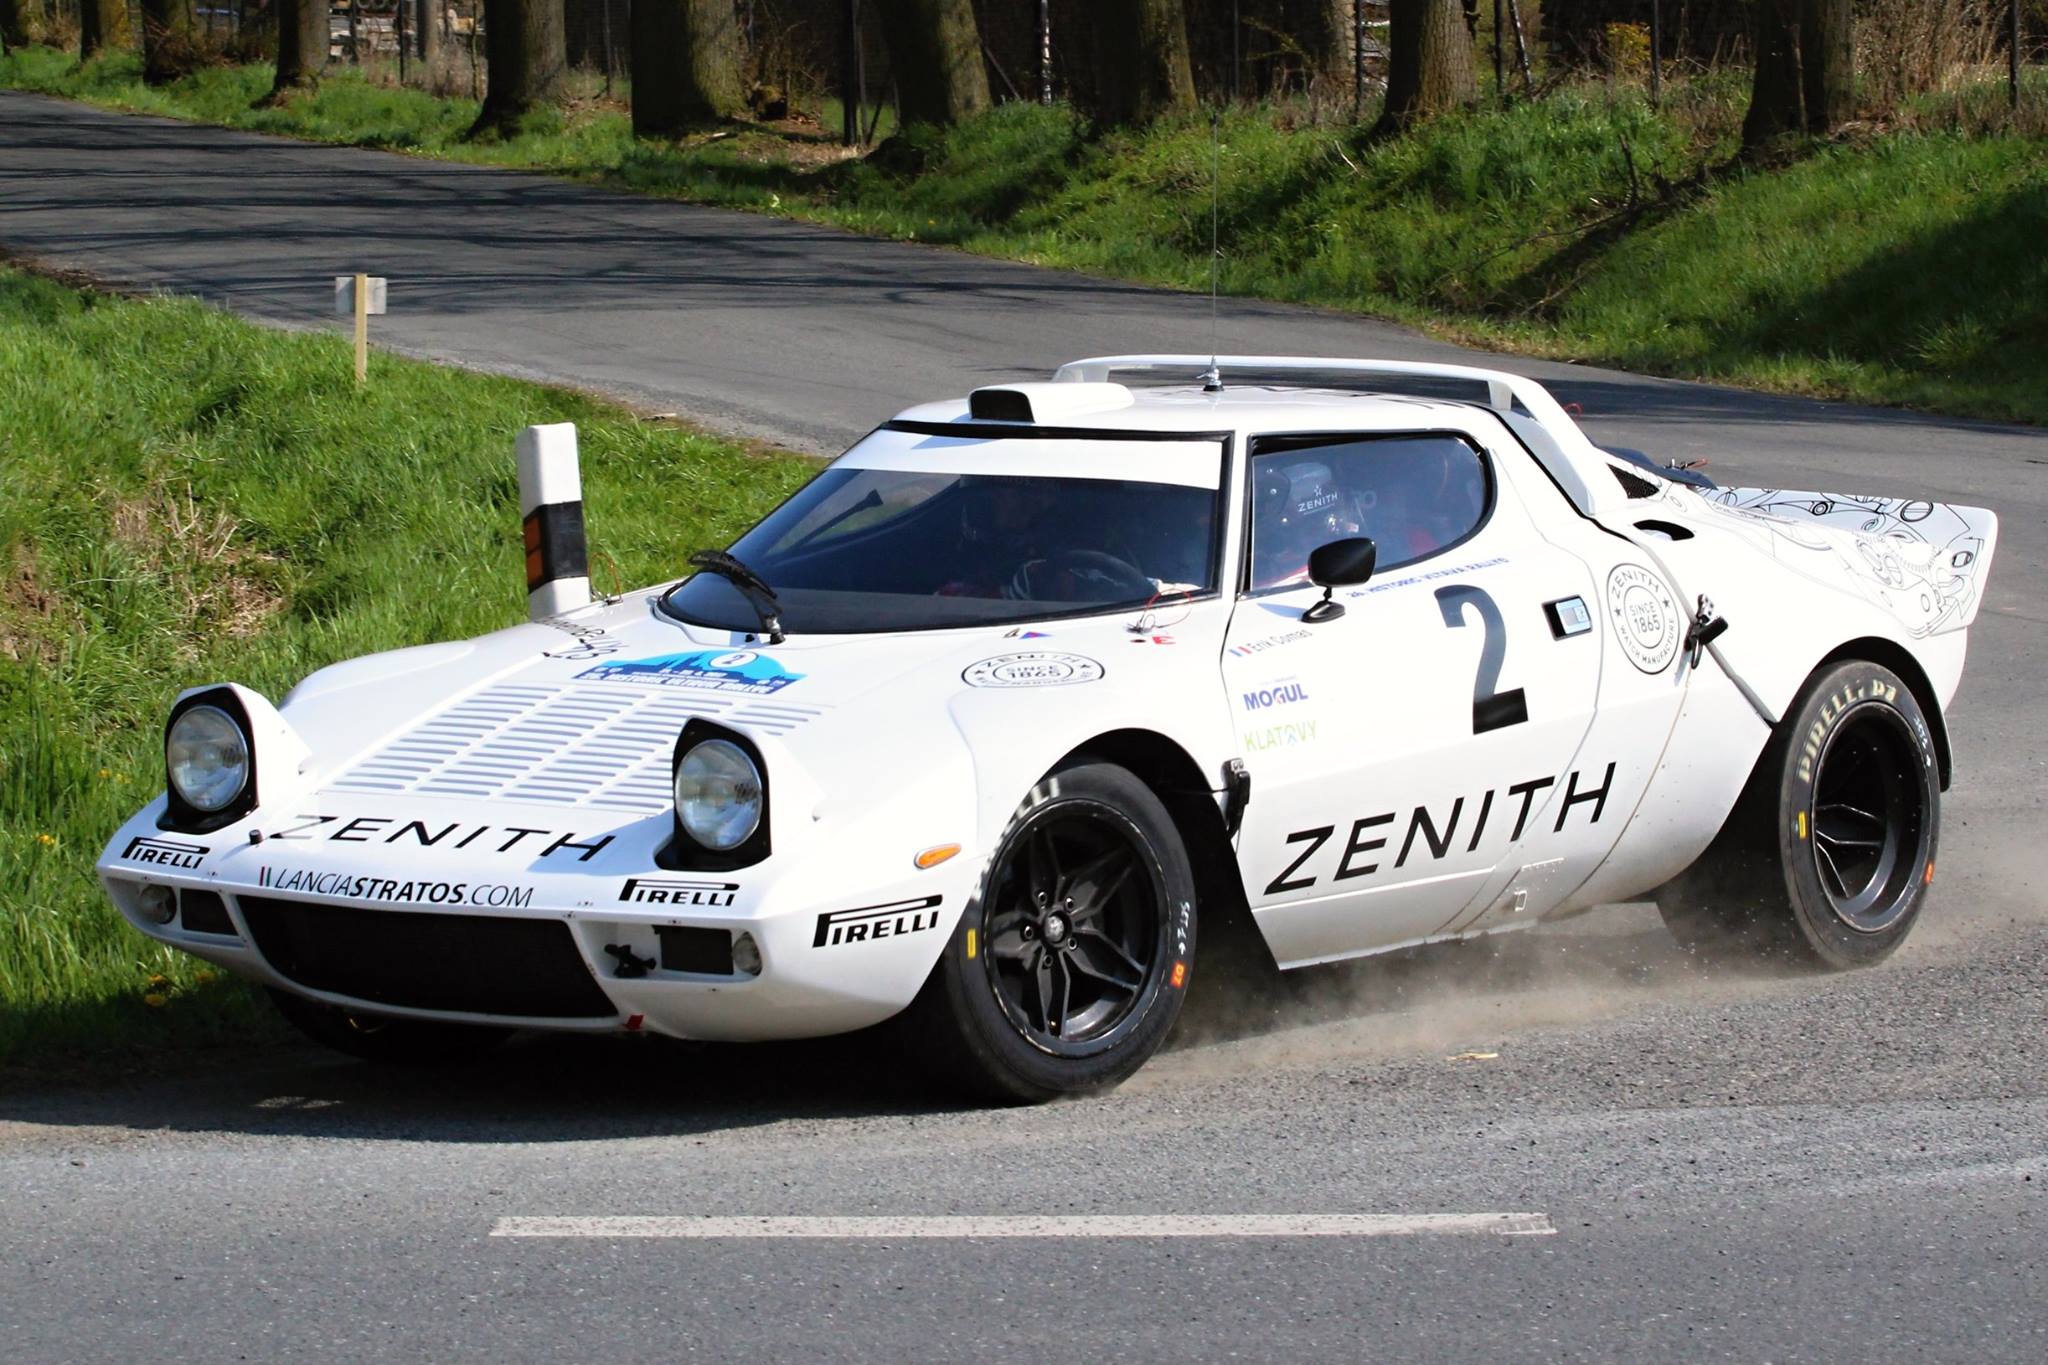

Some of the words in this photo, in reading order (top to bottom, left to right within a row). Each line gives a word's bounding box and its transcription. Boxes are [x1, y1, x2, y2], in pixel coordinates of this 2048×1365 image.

[1297, 492, 1338, 513] ZENITH
[1611, 570, 1660, 599] ZENITH
[1629, 601, 1656, 616] SINCE
[1633, 614, 1660, 634] 1865
[1642, 619, 1675, 665] MANUFACTURE
[1434, 584, 1528, 735] 2
[1243, 683, 1309, 711] MOGUL
[1244, 720, 1318, 752] KLATOVY
[1798, 679, 1865, 784] PIRELLI
[270, 815, 616, 862] ZENITH
[1263, 762, 1617, 896] ZENITH
[121, 836, 210, 869] PIRELLI
[274, 868, 535, 908] LANCIASTRATOS.COM
[618, 878, 740, 907] PIRELLI
[812, 894, 943, 948] PIRELLI
